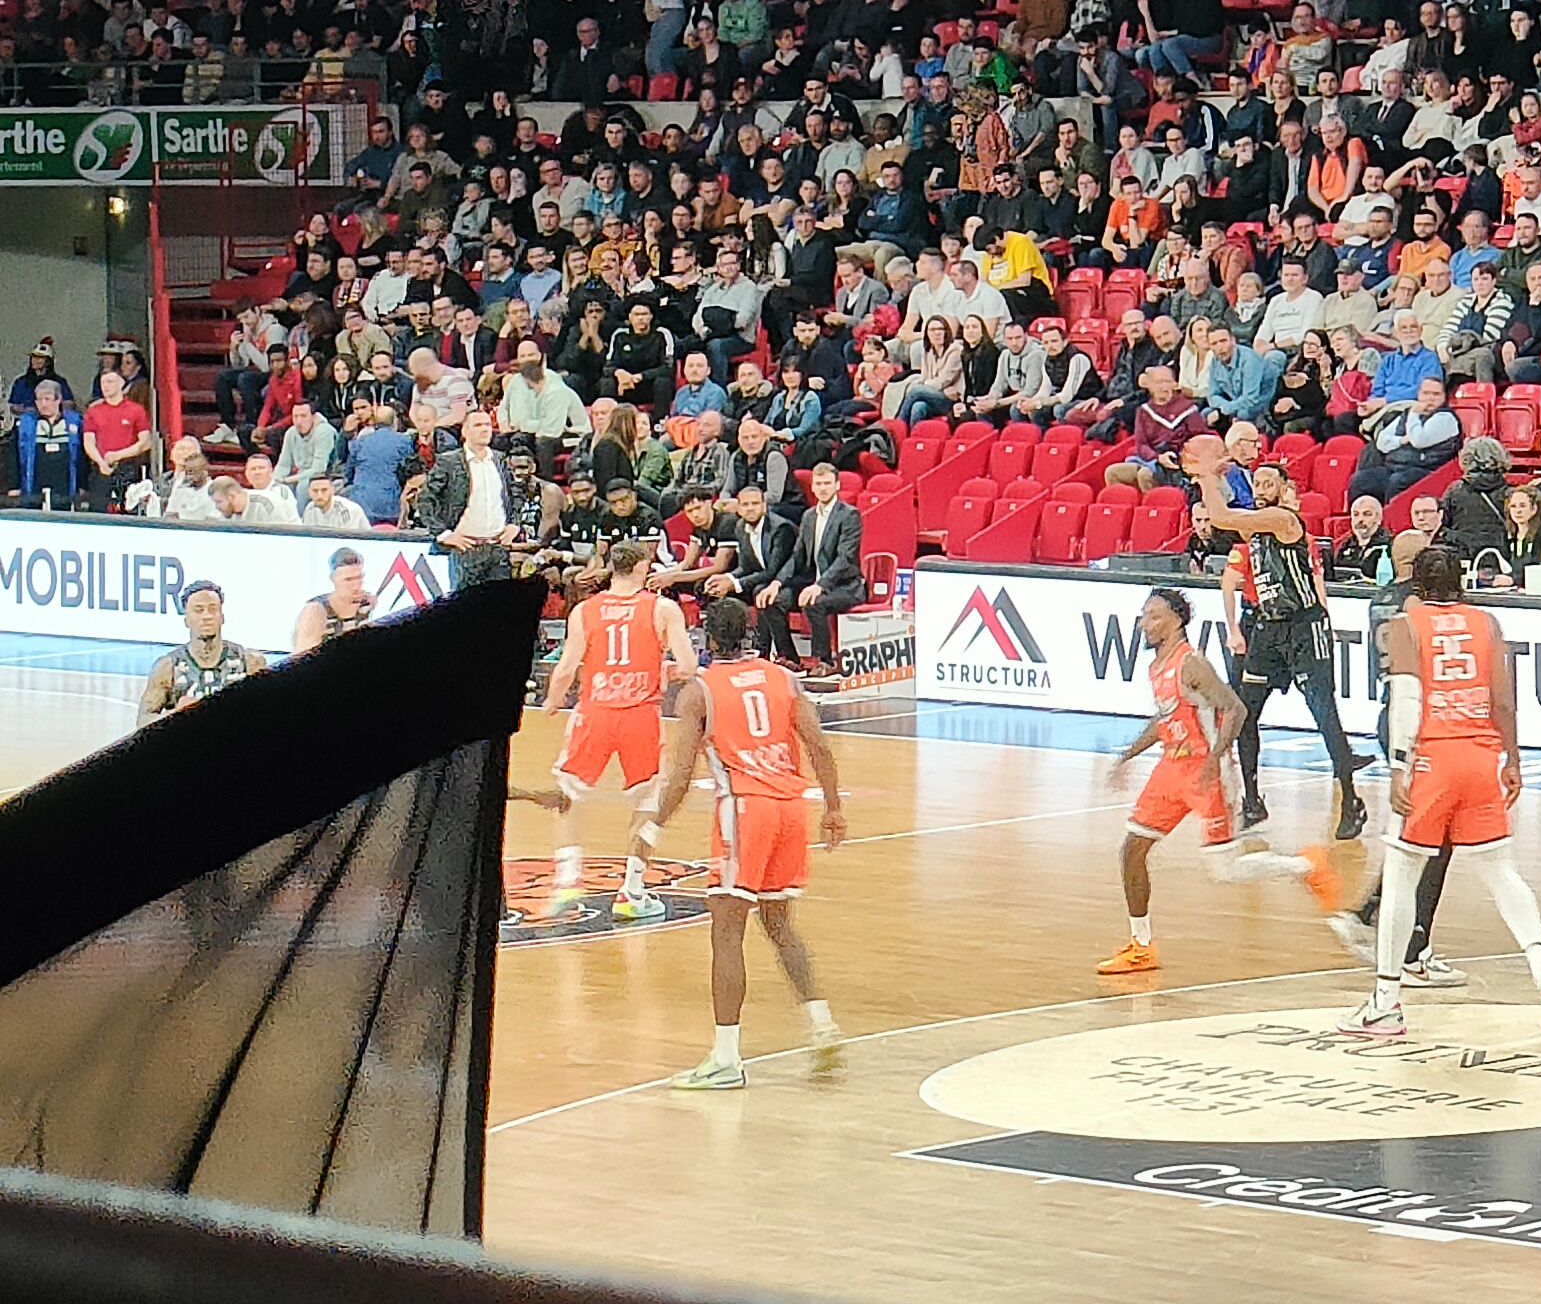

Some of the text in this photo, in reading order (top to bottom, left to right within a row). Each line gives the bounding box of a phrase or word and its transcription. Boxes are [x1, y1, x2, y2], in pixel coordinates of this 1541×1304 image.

[164, 118, 248, 153] Sarthe
[0, 547, 187, 616] MOBILIER
[605, 623, 631, 666] 11
[936, 662, 1052, 689] STRUCTURA
[742, 690, 771, 737] 0
[1090, 1072, 1416, 1117] FAMILIALE
[1110, 1056, 1522, 1113] CHARCUTERIE
[1125, 1093, 1264, 1117] 1931
[1133, 1163, 1435, 1221] Crédit
